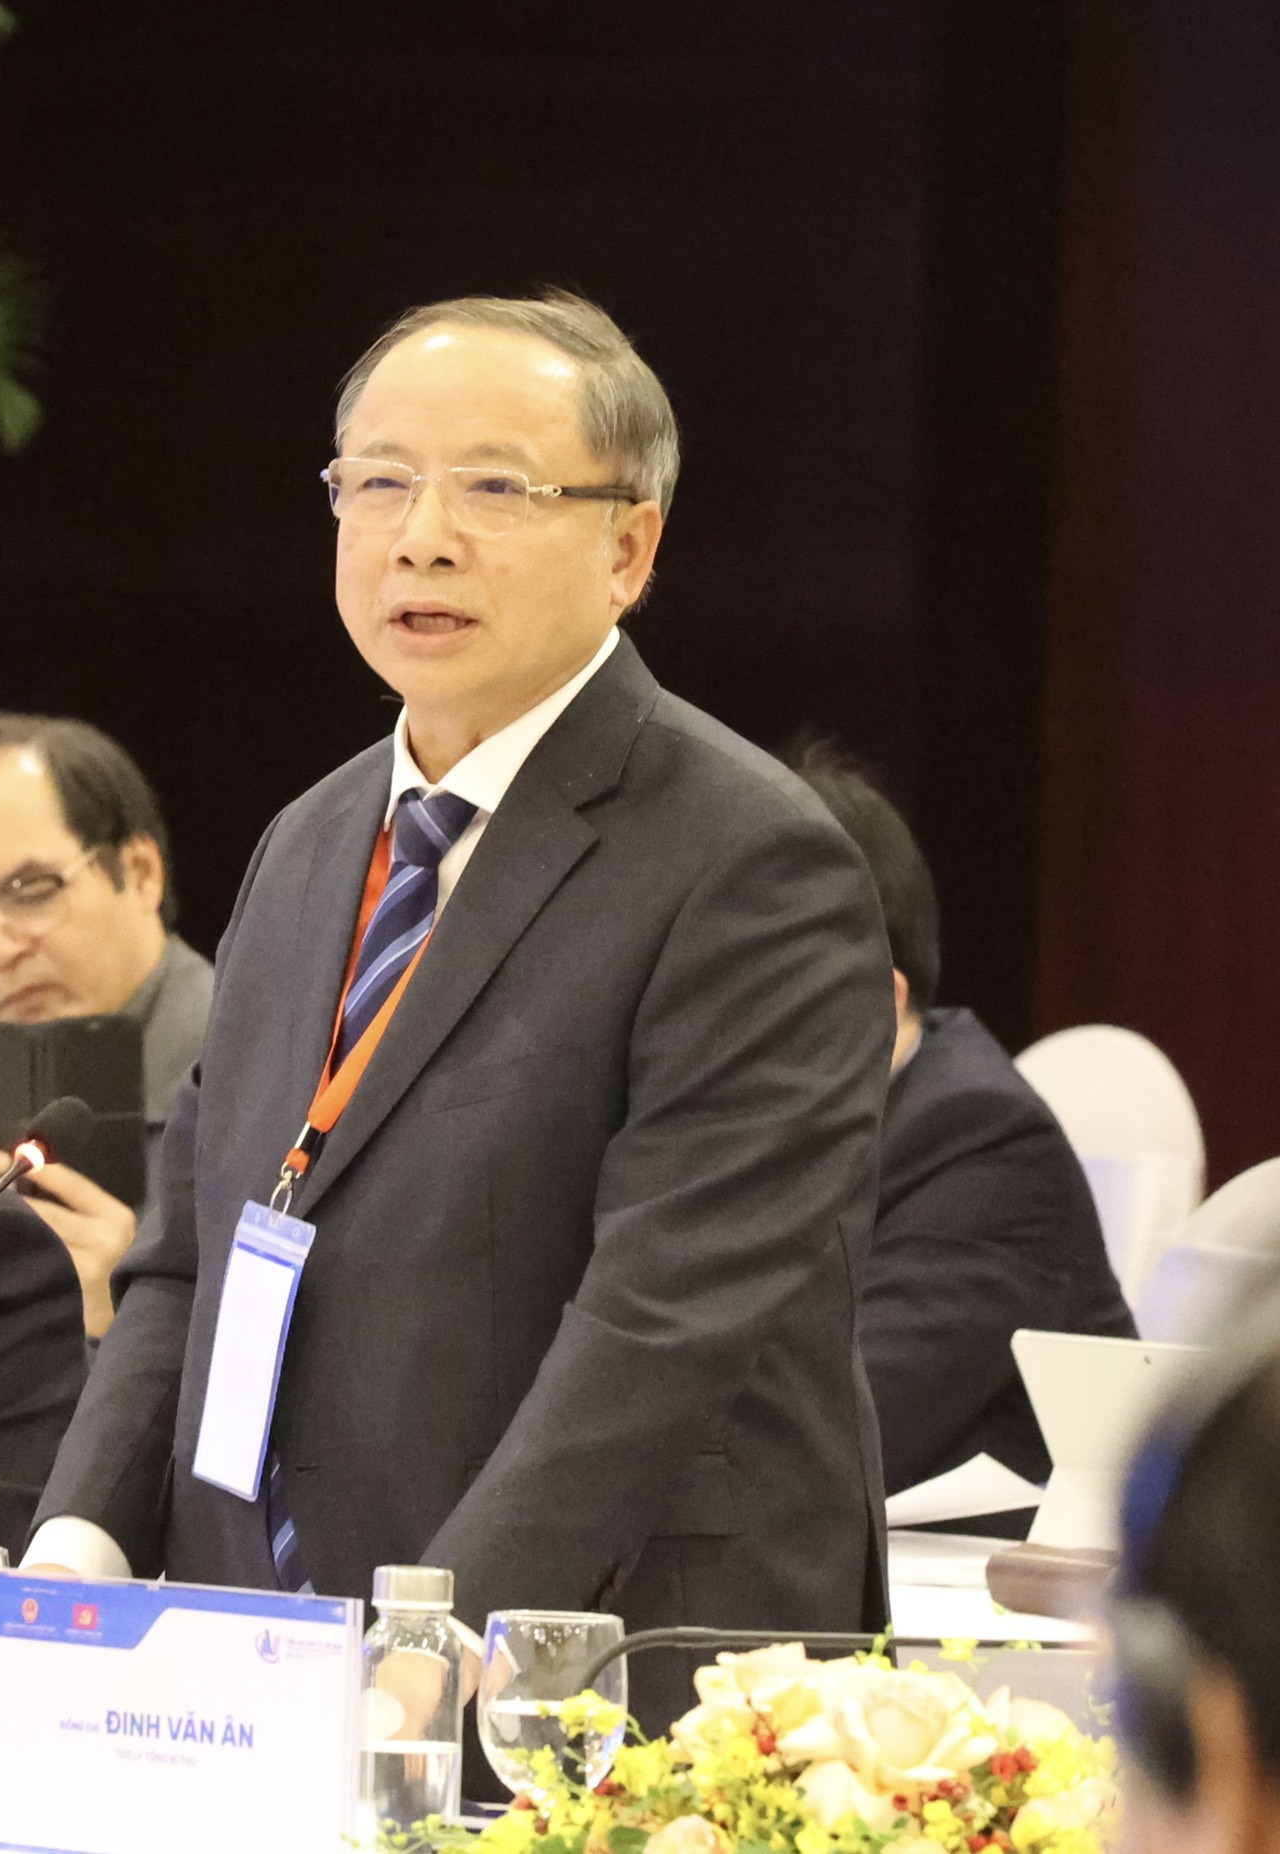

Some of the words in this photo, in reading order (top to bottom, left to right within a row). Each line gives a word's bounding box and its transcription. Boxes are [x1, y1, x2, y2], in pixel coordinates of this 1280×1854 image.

[105, 1710, 160, 1739] ĐINH
[168, 1710, 215, 1744] VĂN
[221, 1714, 253, 1748] ÂN
